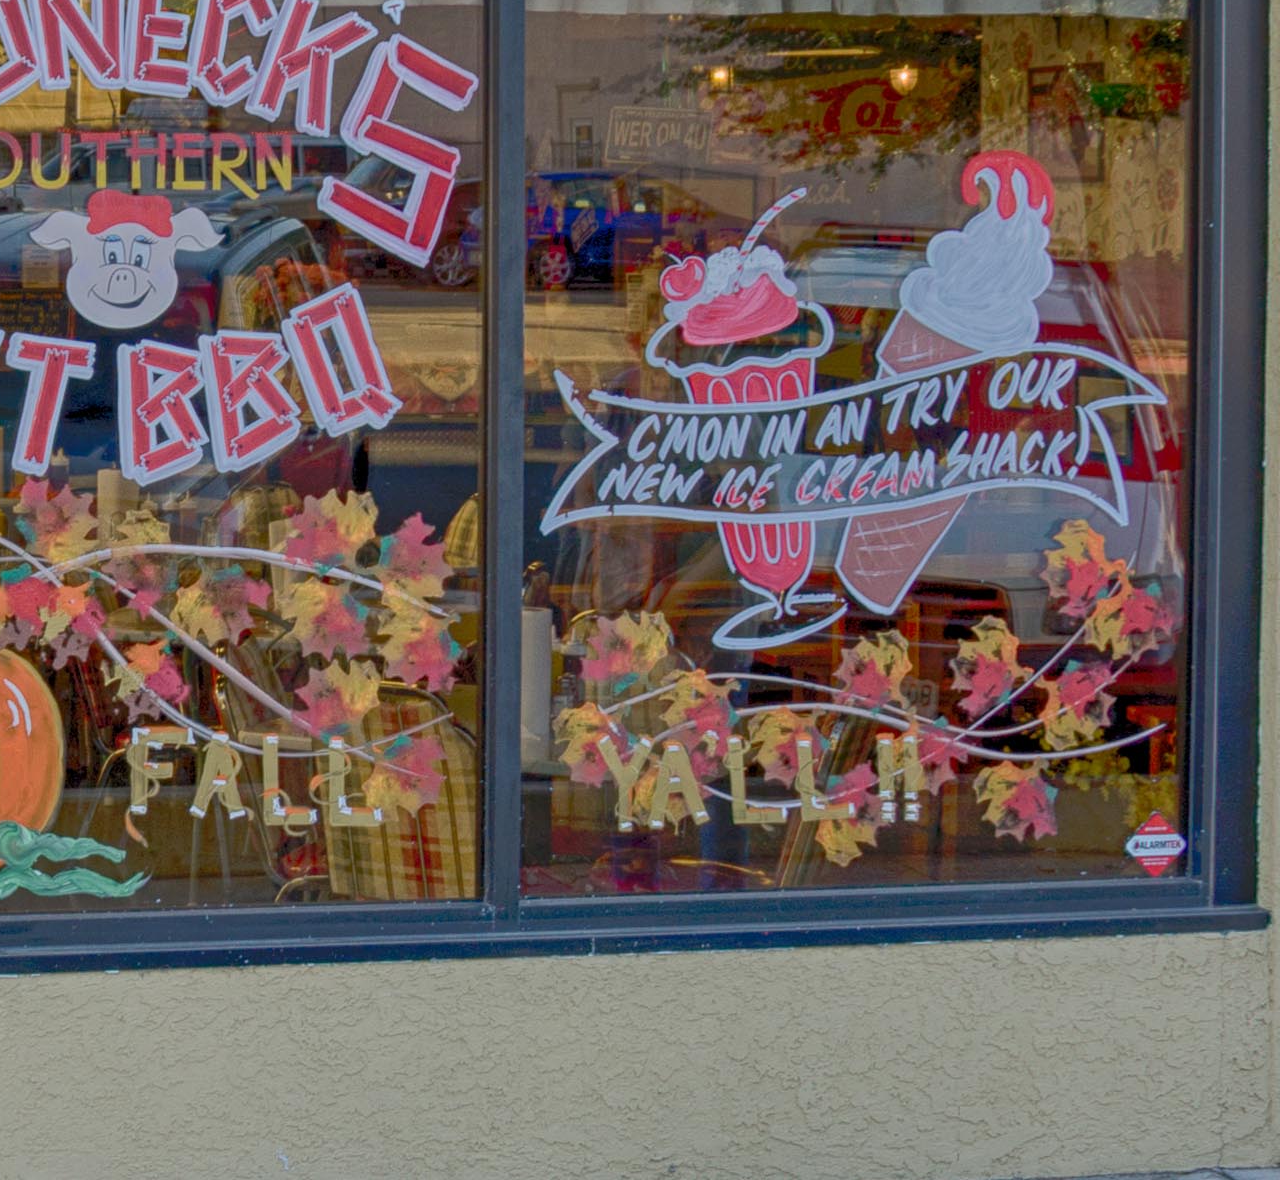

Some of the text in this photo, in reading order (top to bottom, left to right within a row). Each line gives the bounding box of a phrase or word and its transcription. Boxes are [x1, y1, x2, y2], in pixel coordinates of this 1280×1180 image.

[119, 281, 402, 486] BBQ
[627, 357, 1078, 463] C'MON IN AN TRY OUR
[598, 406, 1093, 512] NEW ICE CREAM SHACK!
[126, 724, 384, 834] FALL
